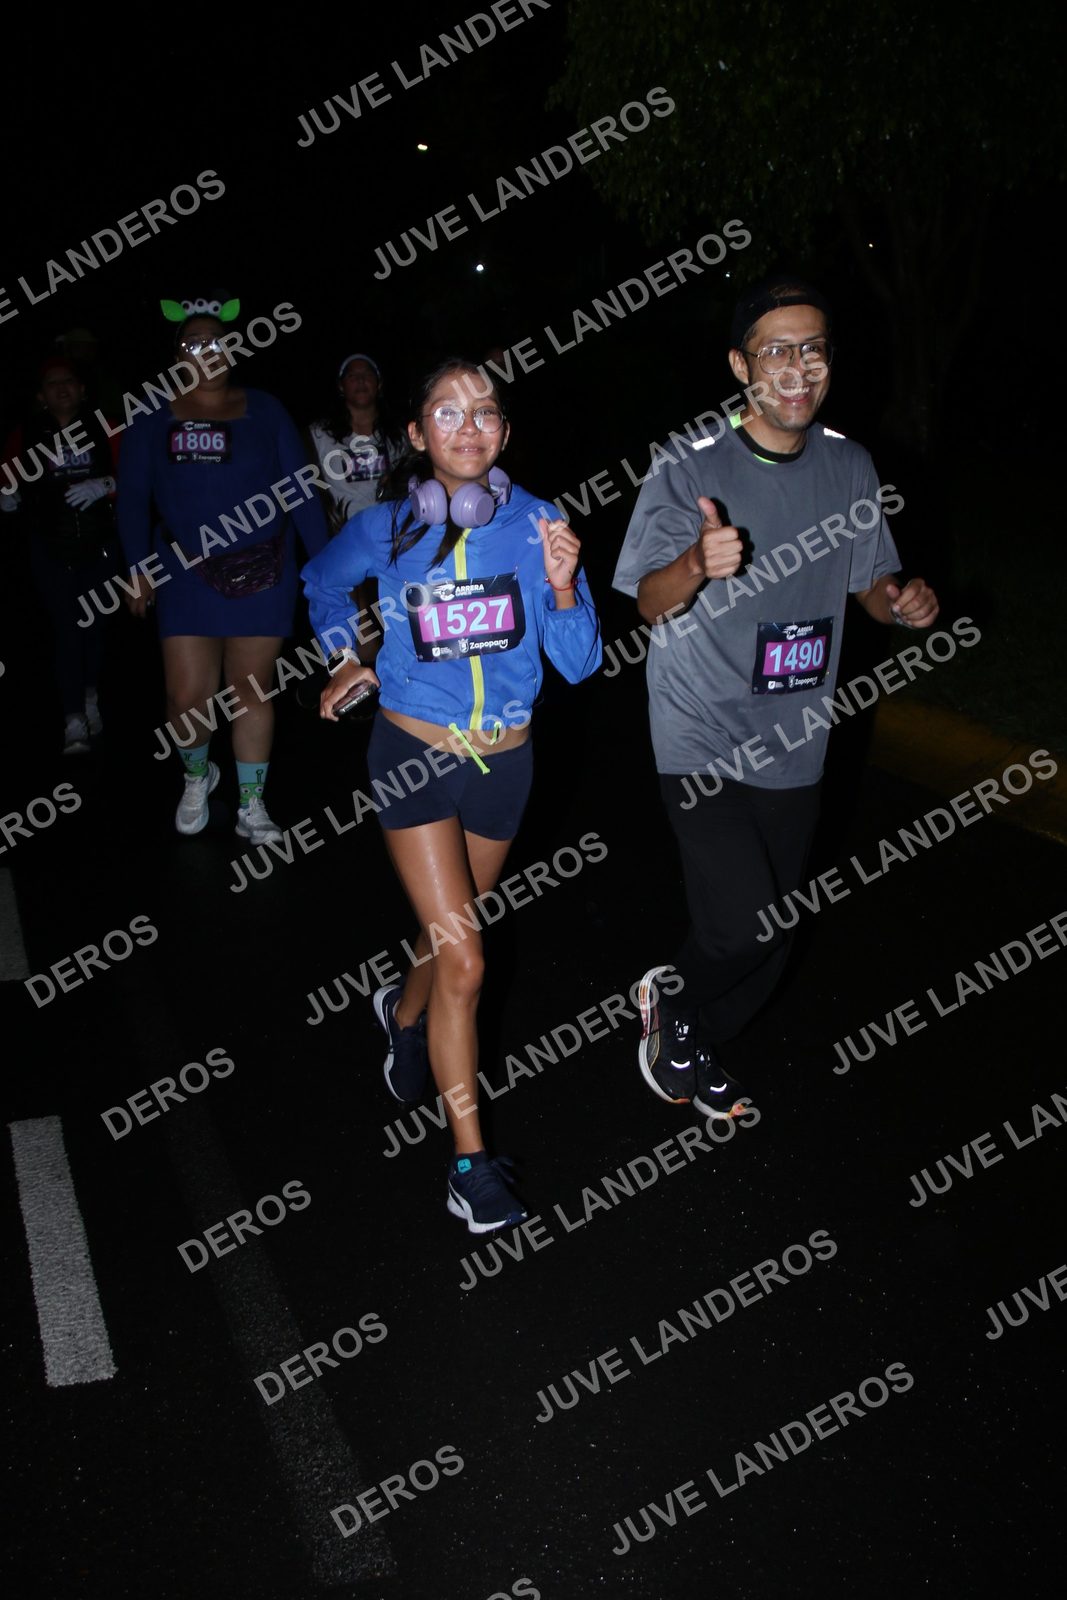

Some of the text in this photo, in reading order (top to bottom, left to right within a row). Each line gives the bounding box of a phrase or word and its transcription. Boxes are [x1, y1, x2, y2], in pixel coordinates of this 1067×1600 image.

[174, 432, 225, 450] 1806
[424, 598, 509, 638] 1527
[770, 639, 824, 673] 1490
